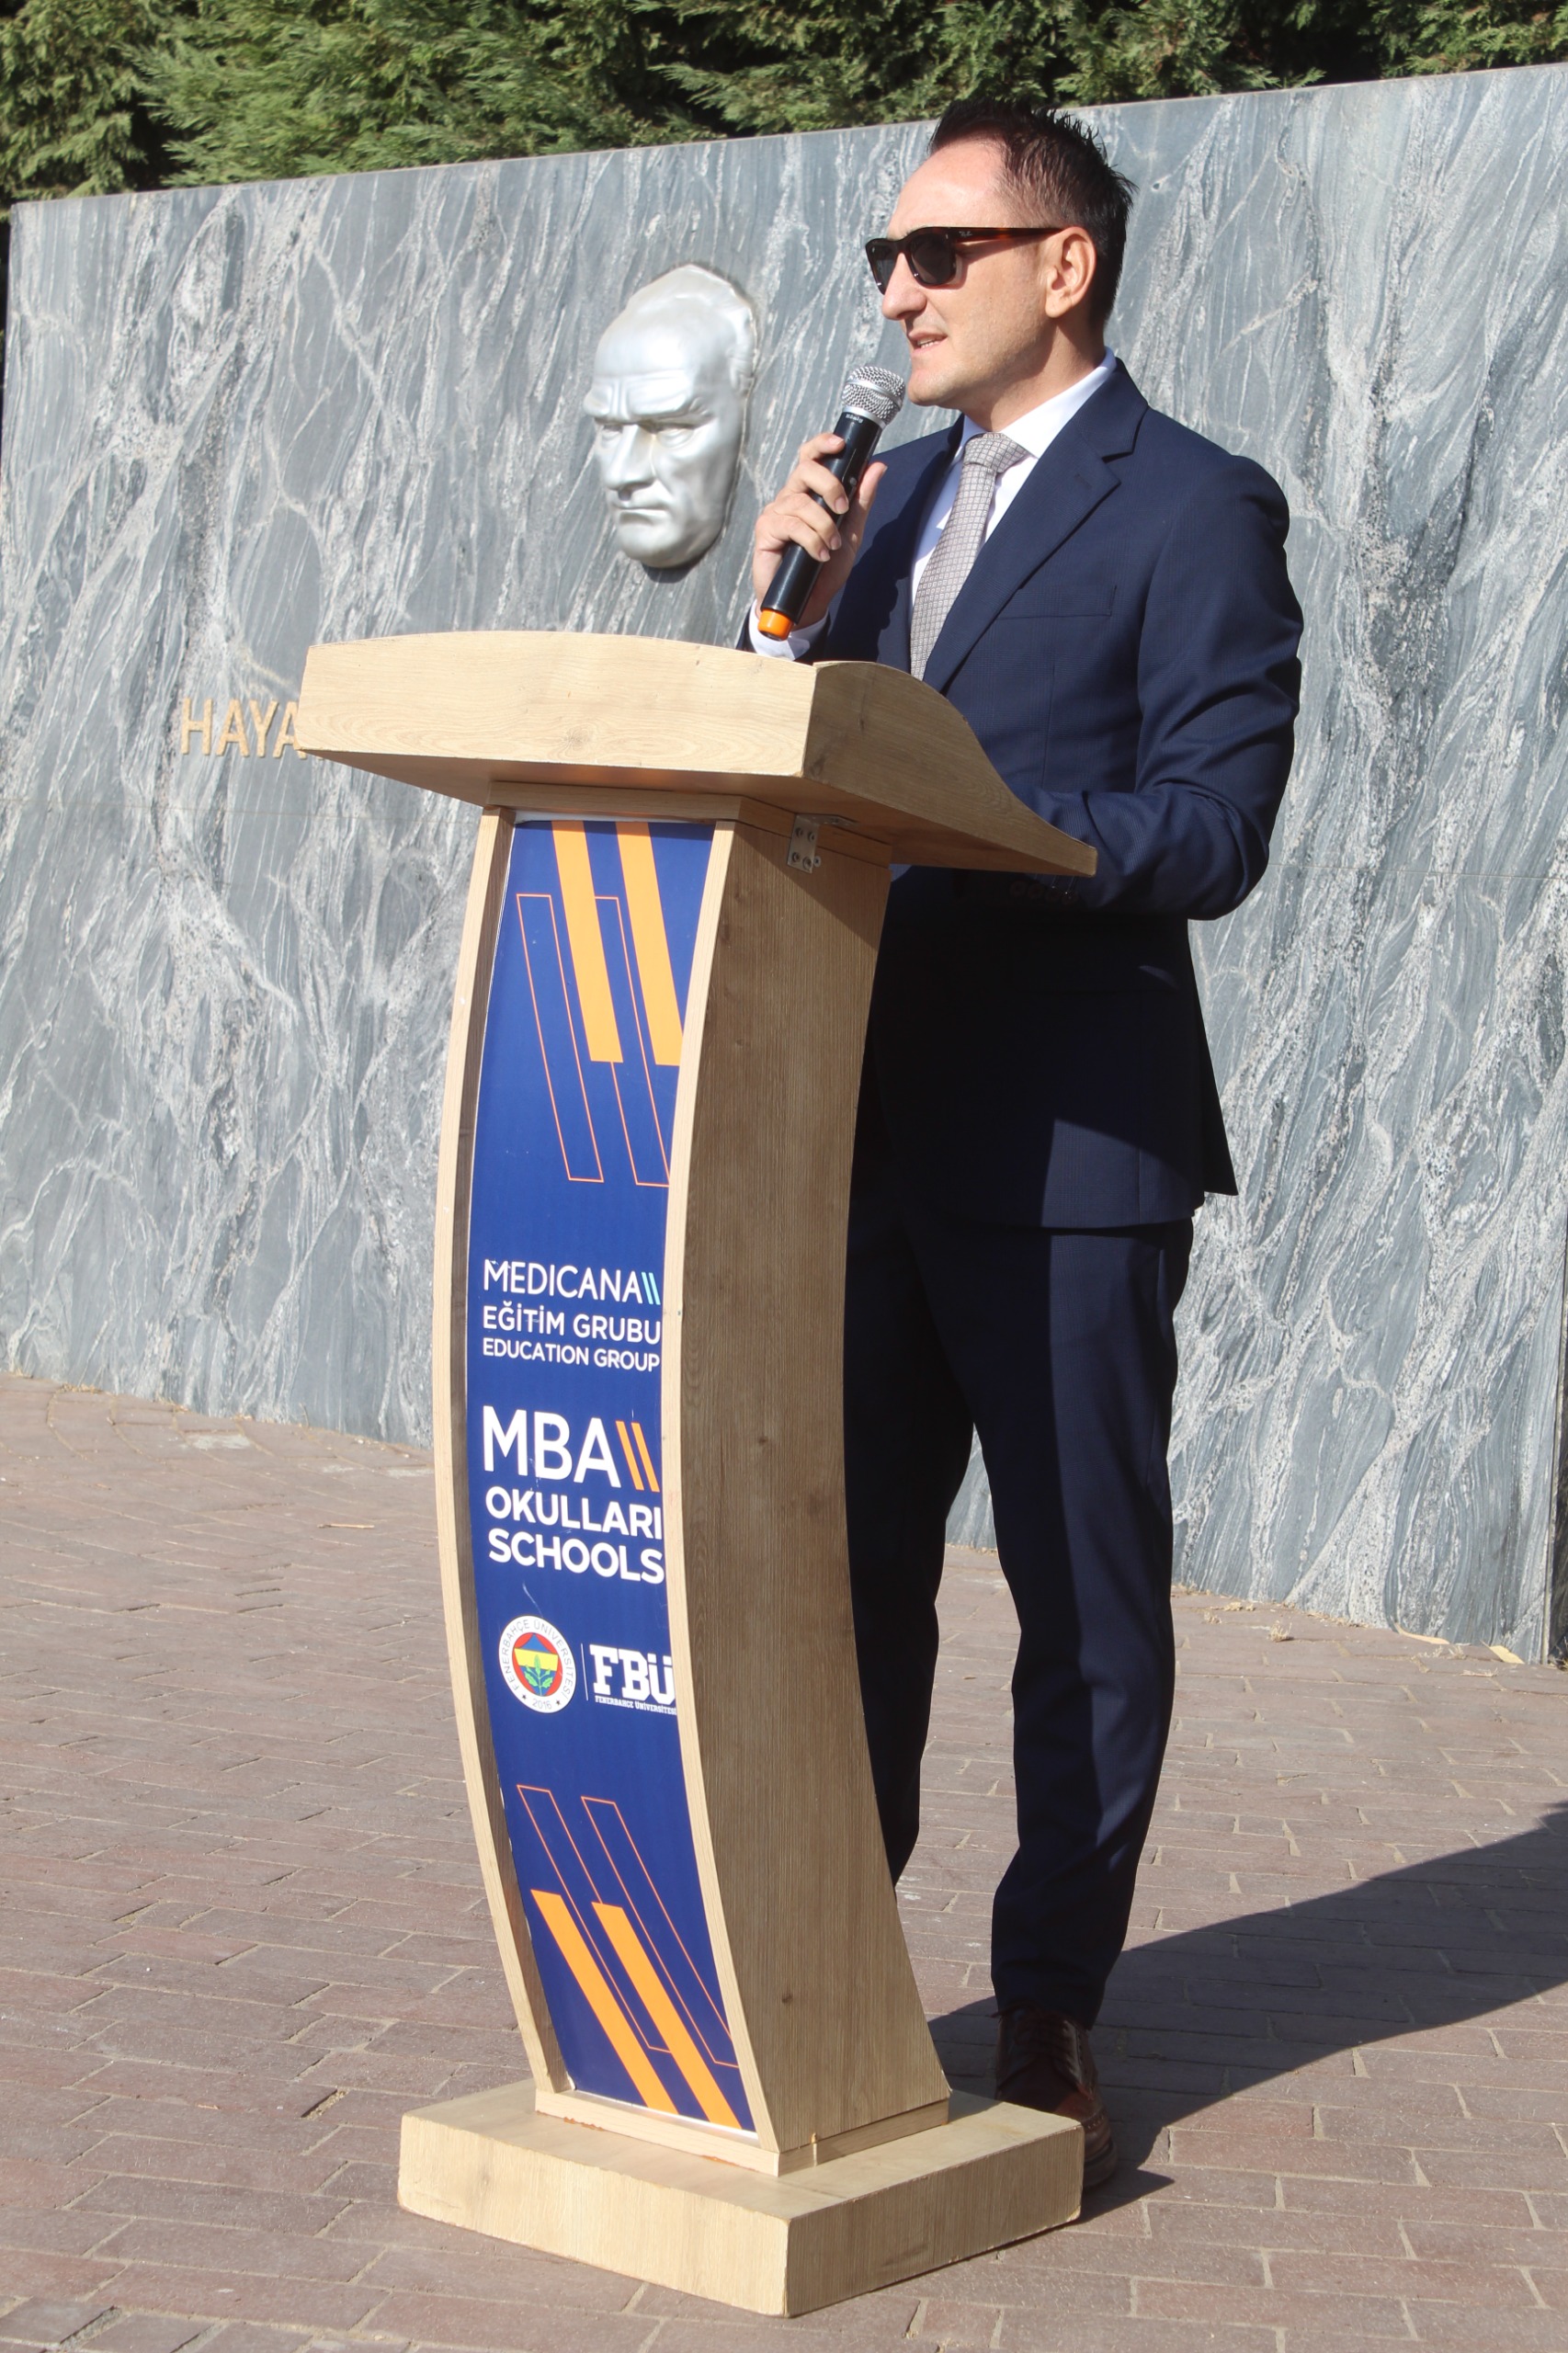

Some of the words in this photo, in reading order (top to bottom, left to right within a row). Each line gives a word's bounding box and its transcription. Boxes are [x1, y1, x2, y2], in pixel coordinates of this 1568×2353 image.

[180, 698, 324, 761] HAYA
[483, 1259, 643, 1304] MEDICANA
[483, 1301, 565, 1336] EĞİTİM
[573, 1313, 661, 1345] GRUBU
[483, 1337, 589, 1366] EDUCATION
[594, 1348, 660, 1372] GROUP
[483, 1405, 622, 1488] MBA
[485, 1485, 663, 1540] OKULLARI
[488, 1528, 665, 1585] SCHOOLS
[589, 1643, 676, 1706] FBÜ
[532, 1698, 552, 1711] 2016
